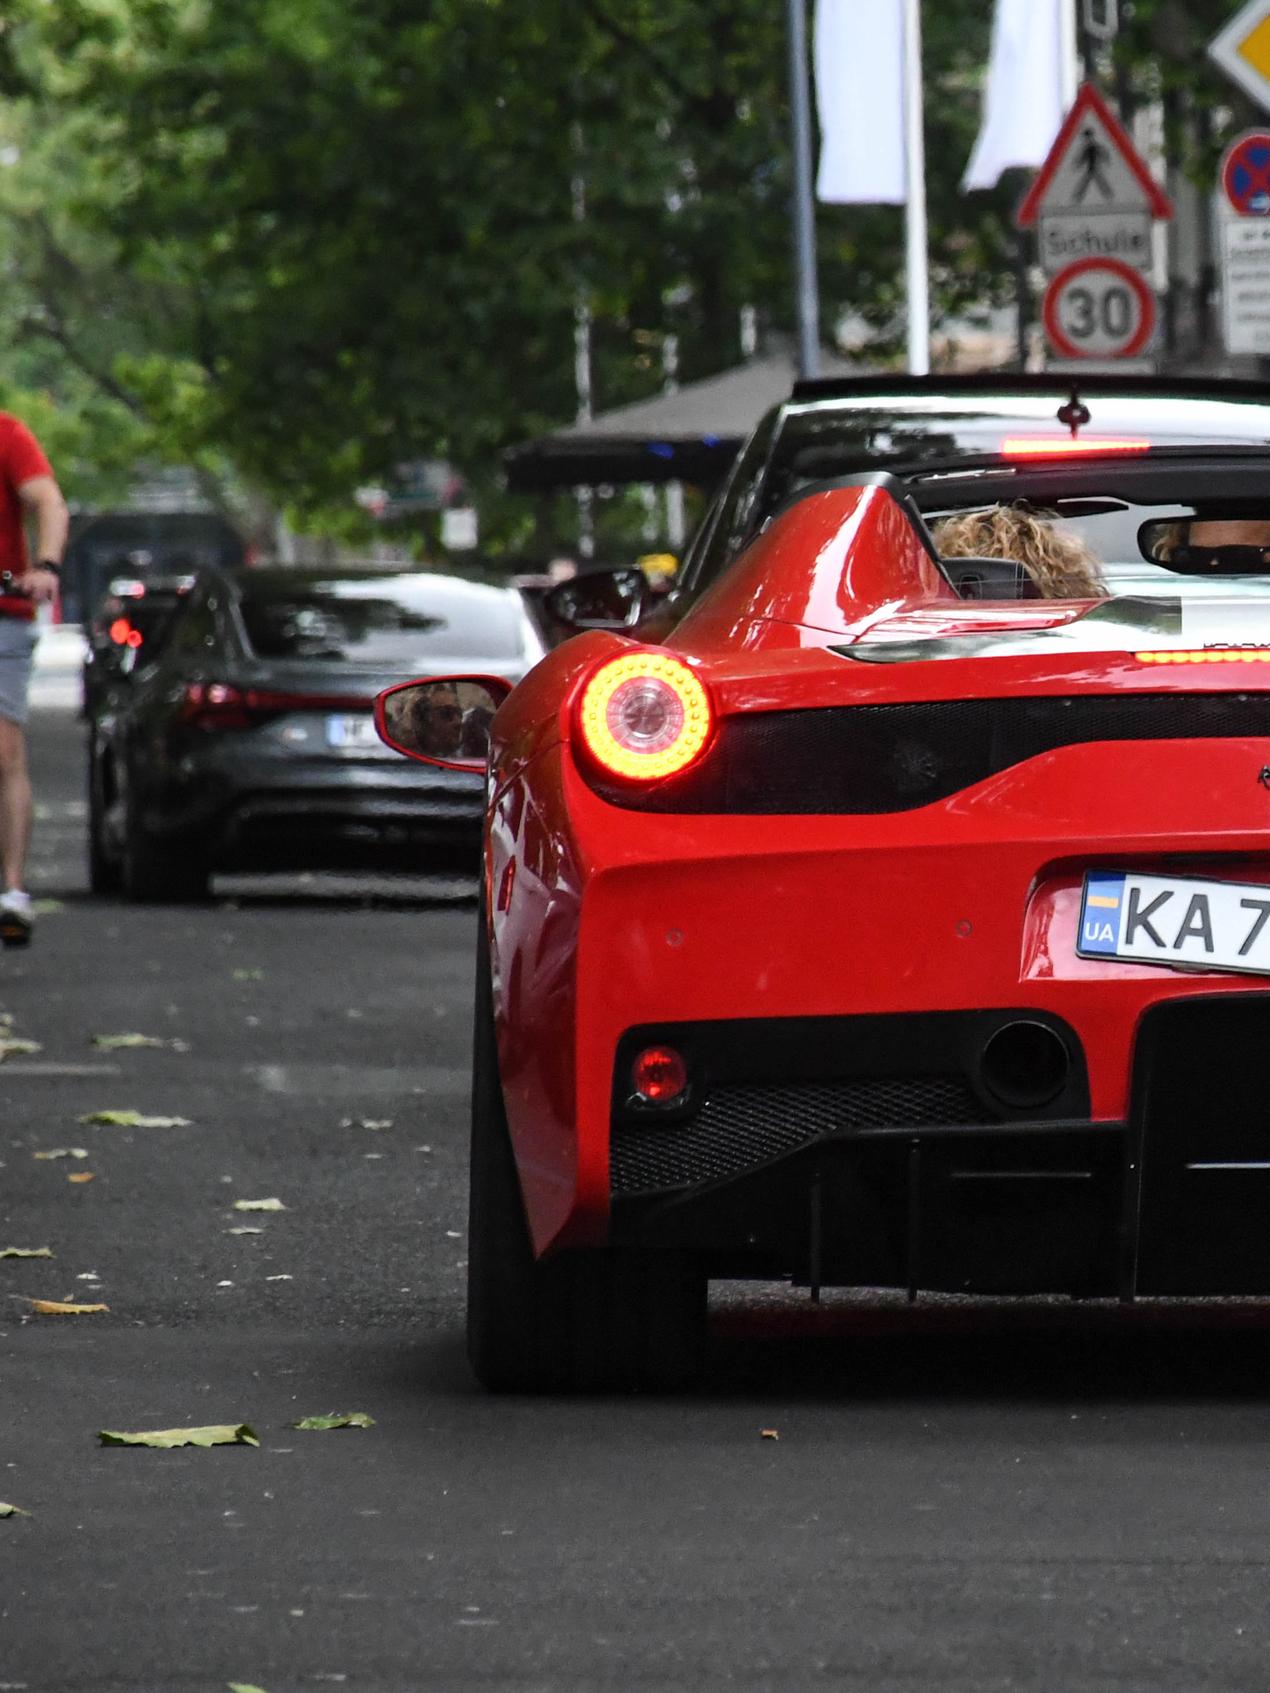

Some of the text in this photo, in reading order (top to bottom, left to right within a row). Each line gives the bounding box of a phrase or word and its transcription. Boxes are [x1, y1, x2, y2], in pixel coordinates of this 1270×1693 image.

[1048, 227, 1145, 254] Schule
[1067, 287, 1132, 338] 30
[1085, 922, 1114, 943] UA
[1124, 887, 1214, 953] KA
